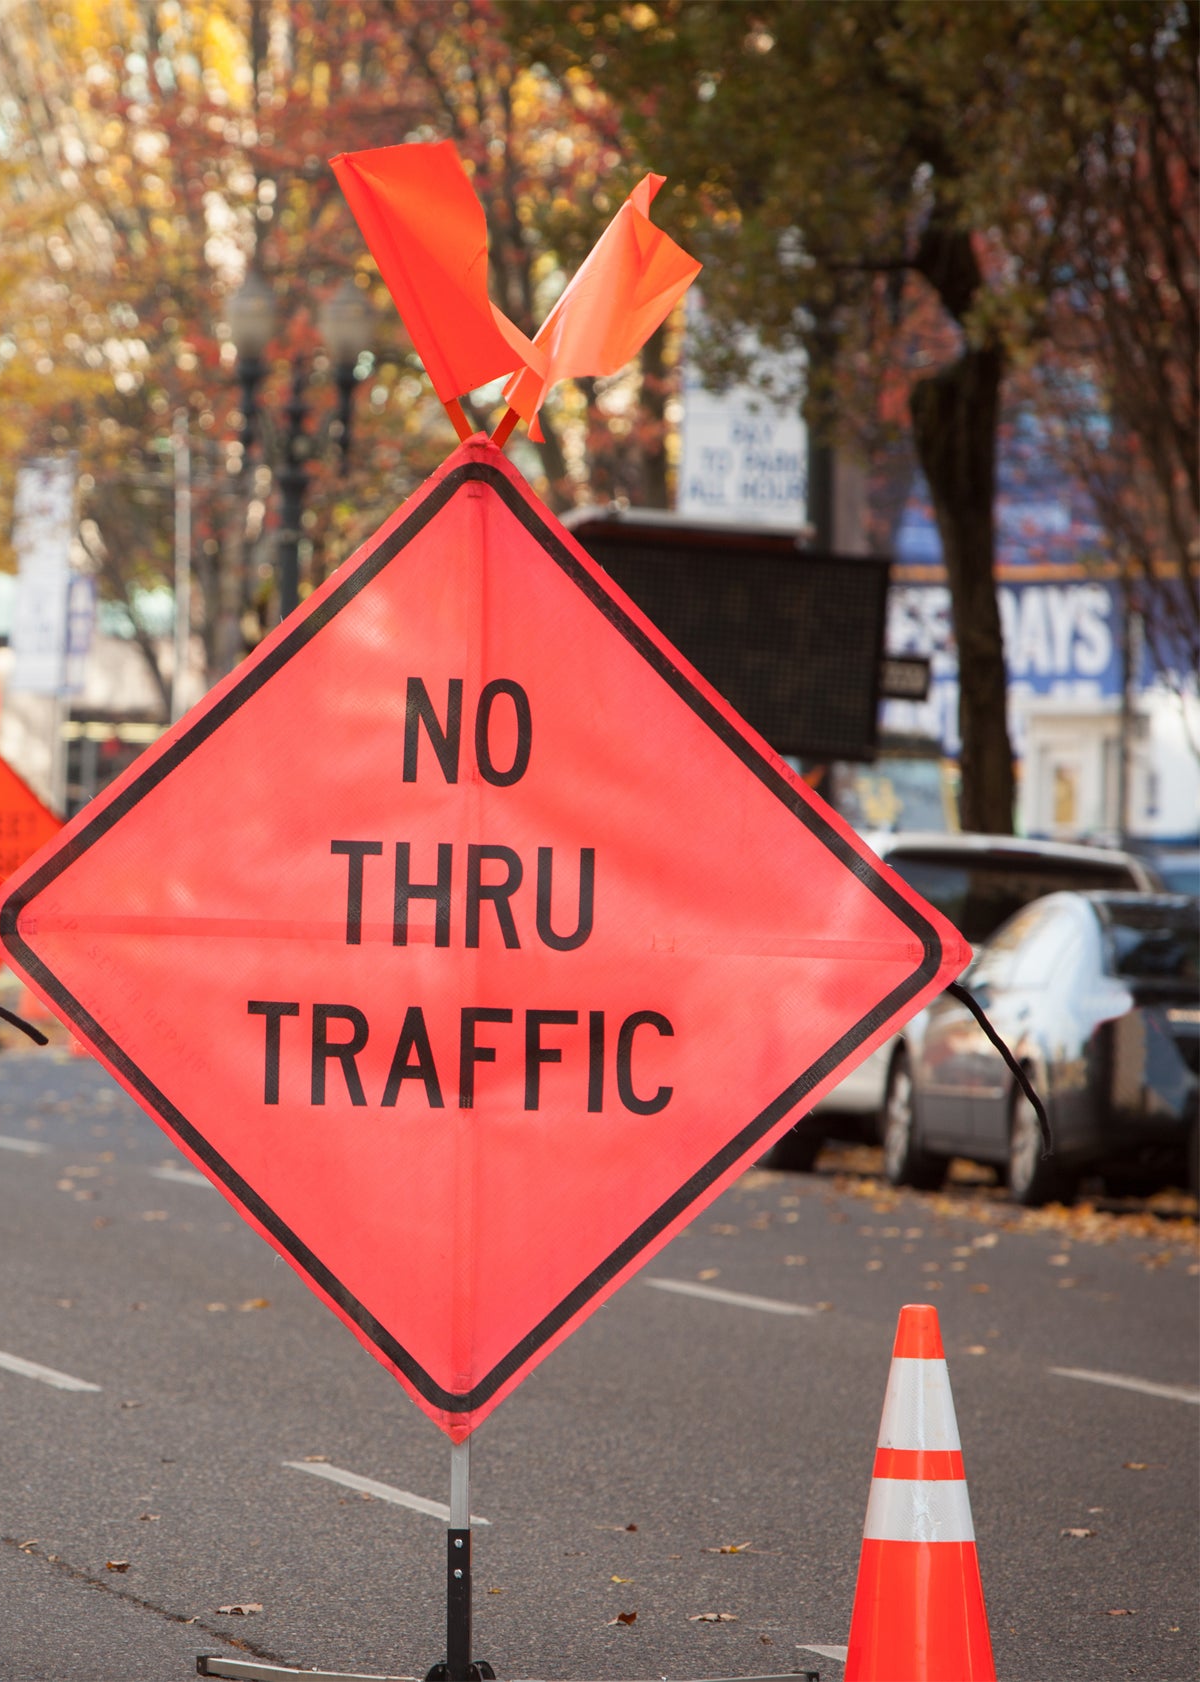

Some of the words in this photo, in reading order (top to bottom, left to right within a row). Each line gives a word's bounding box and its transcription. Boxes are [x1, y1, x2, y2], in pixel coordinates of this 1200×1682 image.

[403, 677, 532, 787] NO
[331, 840, 595, 951] THRU
[248, 1000, 674, 1116] TRAFFIC
